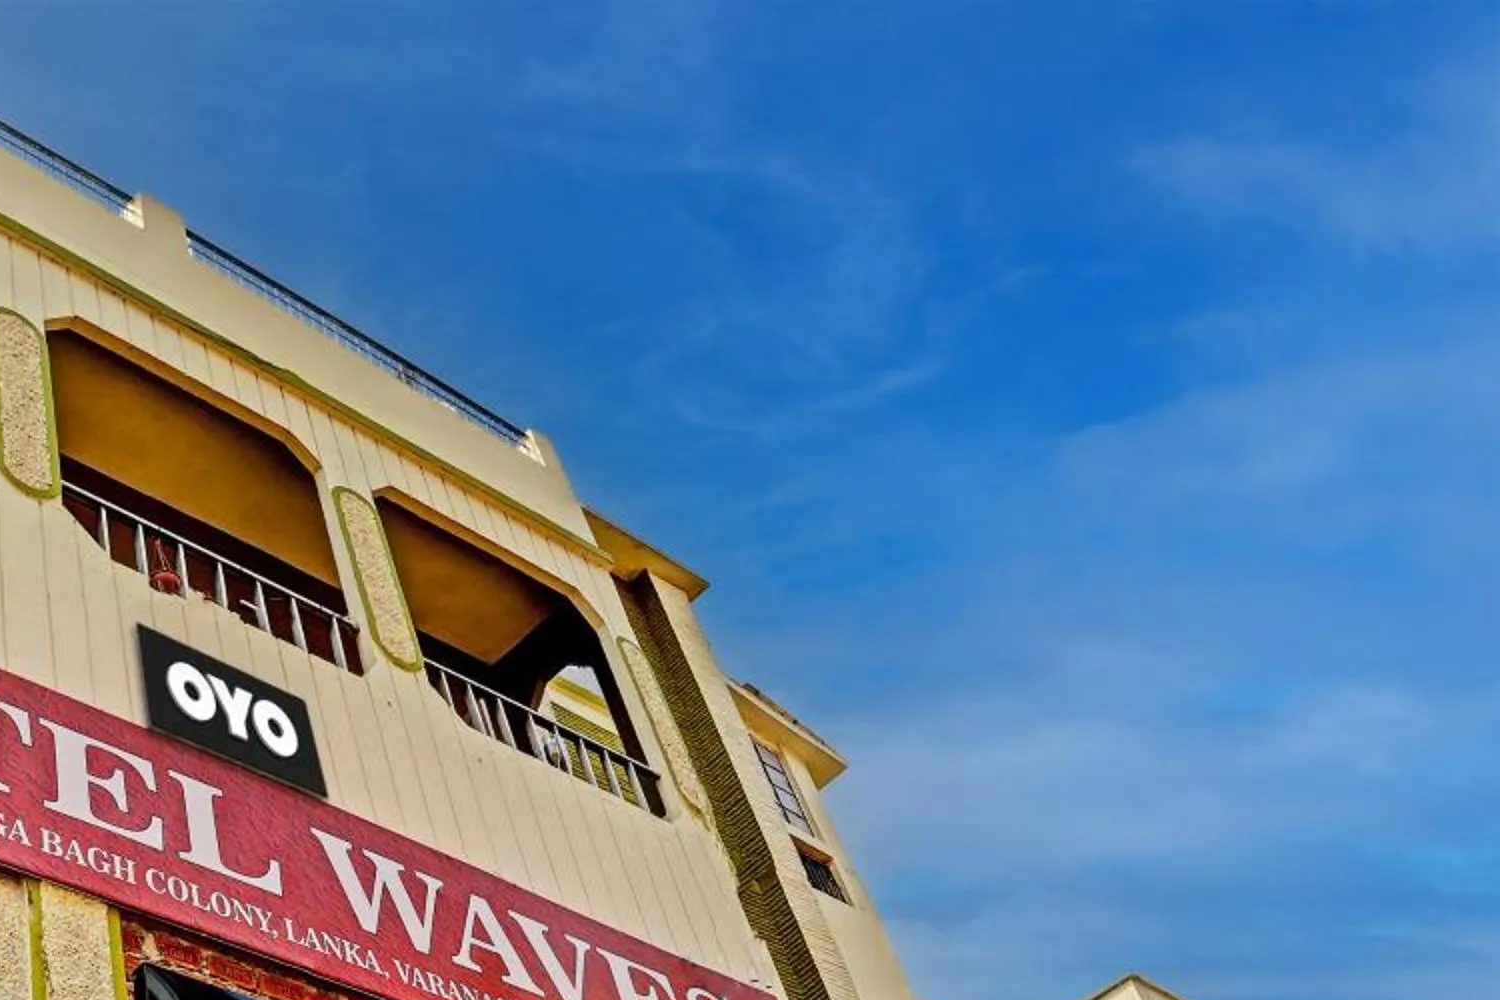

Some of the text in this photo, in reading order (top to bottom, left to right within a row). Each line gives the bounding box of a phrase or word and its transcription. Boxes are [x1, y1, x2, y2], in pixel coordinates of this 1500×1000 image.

[166, 661, 299, 758] OYO
[40, 827, 137, 885] BAGH
[144, 868, 279, 939] COLONY,
[285, 920, 389, 979] LANKA,
